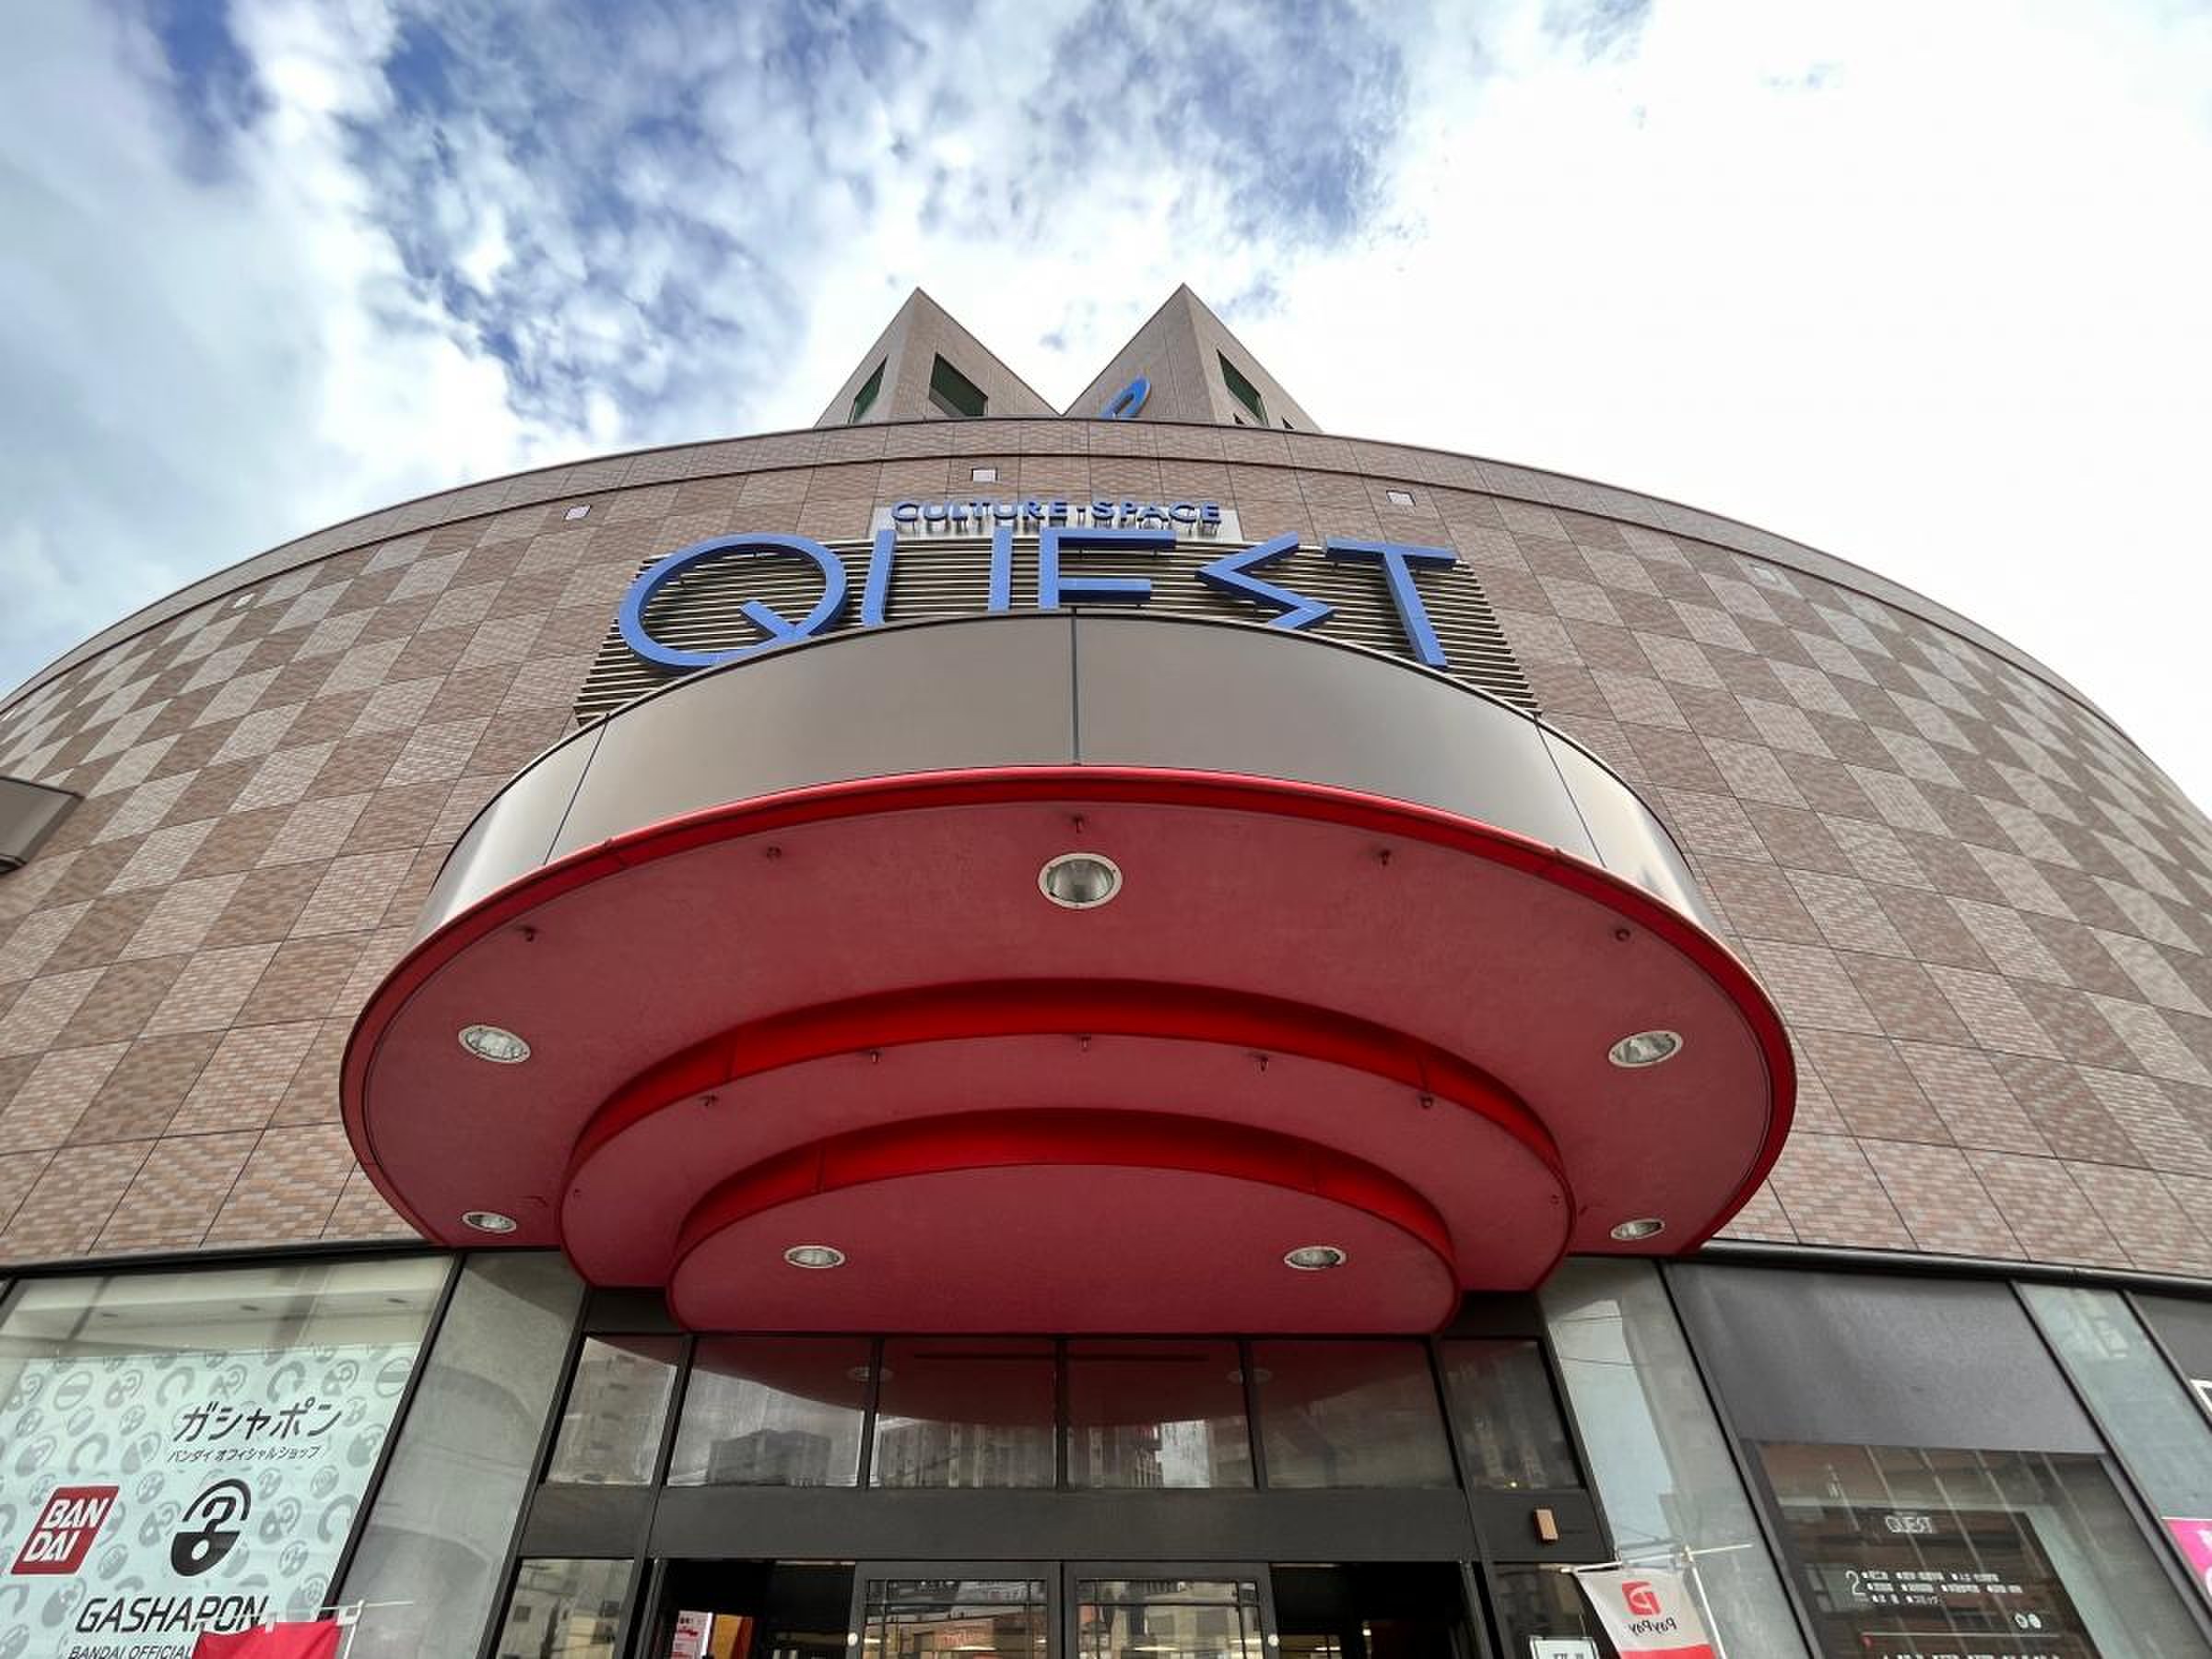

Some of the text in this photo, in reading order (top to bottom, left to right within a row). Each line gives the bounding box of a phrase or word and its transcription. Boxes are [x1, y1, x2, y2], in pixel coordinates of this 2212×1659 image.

[618, 528, 1459, 670] QUEST
[173, 1396, 342, 1441] ガシャポン
[41, 1498, 110, 1529] BAN
[22, 1530, 81, 1562] DAI
[1845, 1570, 1866, 1595] 2
[76, 1595, 268, 1632] GASHAPON
[68, 1644, 192, 1659] BANDAI OFFICIAL
